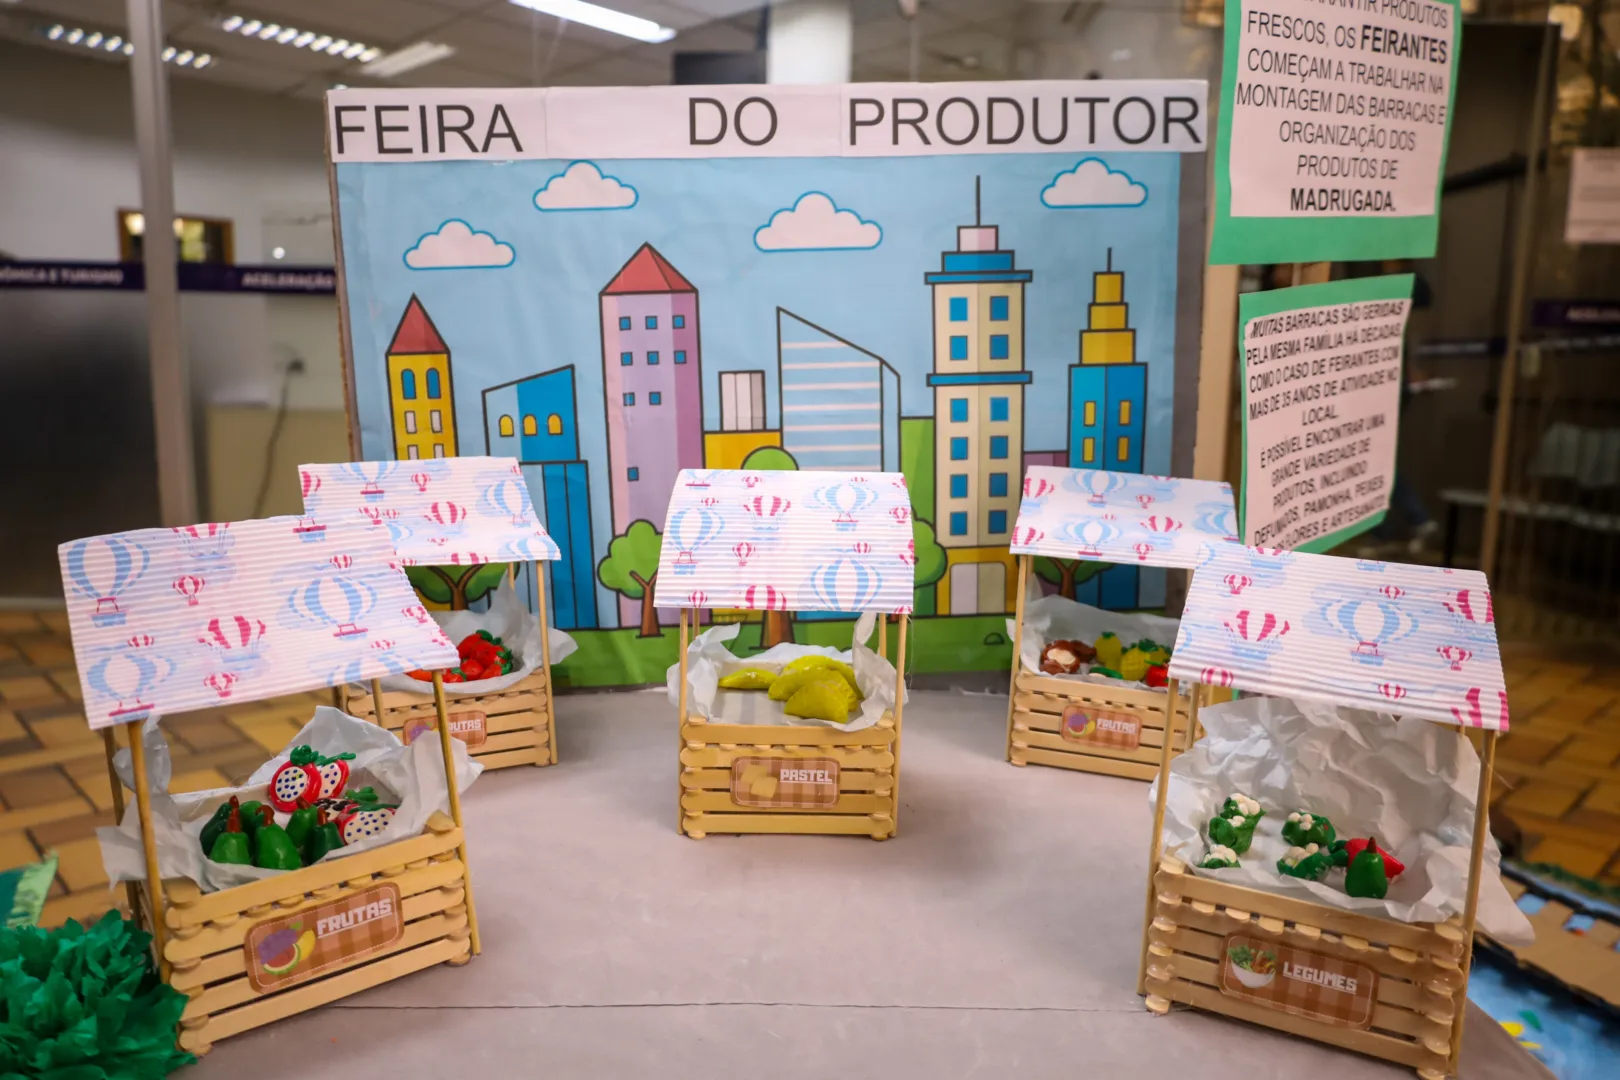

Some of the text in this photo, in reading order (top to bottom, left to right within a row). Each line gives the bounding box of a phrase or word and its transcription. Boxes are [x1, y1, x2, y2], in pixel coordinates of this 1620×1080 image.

[1381, 0, 1448, 29] PRODUTOS
[1247, 10, 1448, 64] FRESCOS, OS FEIRANTES
[1247, 48, 1444, 95] COMEÇAM A TRABALHAR NA
[1236, 82, 1446, 125] MONTAGEM DAS BARRACAS E
[333, 95, 1203, 155] FEIRA DO PRODUTOR
[1279, 120, 1416, 153] ORGANIZAÇÃO DOS
[1297, 154, 1398, 180] PRODUTOS DE
[1290, 187, 1396, 212] MADRUGADA.
[1251, 301, 1404, 338] MUITAS BARRACAS SÃO GERIDAS
[1246, 346, 1269, 367] PELA
[1270, 338, 1301, 361] MESMA
[1304, 330, 1343, 353] FAMÍLIA
[1250, 345, 1399, 393] COMO O CASO DE FEIRANTES COM
[1250, 397, 1269, 420] MAIS
[1270, 394, 1280, 413] DE
[1281, 390, 1291, 408] 35
[1292, 383, 1321, 405] ANOS
[1323, 380, 1338, 399] DE
[1340, 370, 1385, 394] ATIVIDADE
[1267, 434, 1302, 463] POSSÍVEL
[1305, 418, 1364, 448] ENCONTRAR
[1365, 413, 1386, 431] UMA
[1271, 437, 1371, 487] GRANDE VARIEDADE DE
[1320, 460, 1368, 489] INCLUINDO
[1321, 517, 1329, 532] E
[448, 719, 482, 732] RUTAS
[1096, 718, 1137, 734] FRUTAS
[780, 769, 833, 783] PASTEL
[316, 898, 392, 936] FRUTAS
[1282, 961, 1358, 993] LEGUMES
